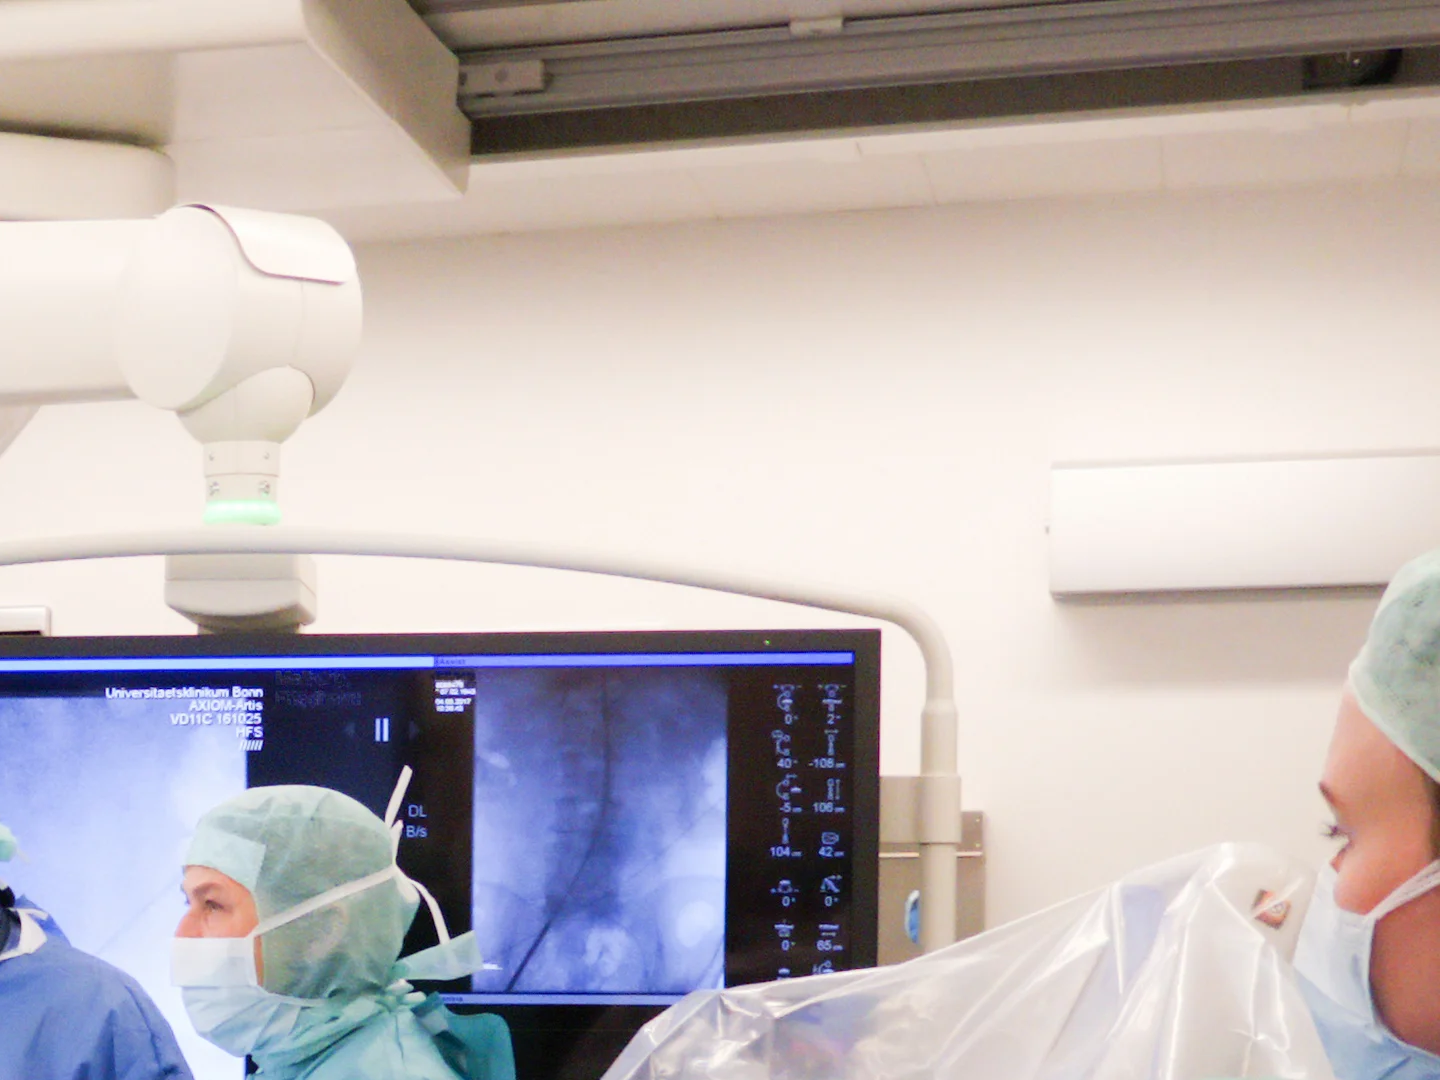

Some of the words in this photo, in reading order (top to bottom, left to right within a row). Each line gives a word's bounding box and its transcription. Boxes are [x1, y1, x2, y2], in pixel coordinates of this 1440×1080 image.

[105, 687, 229, 699] Universitaetsklinikum
[232, 686, 264, 698] Bonn
[189, 700, 264, 711] AXIOM-Artis
[170, 713, 213, 725] VD11C
[217, 713, 262, 725] 161025
[236, 726, 264, 738] HFS
[408, 804, 427, 818] DL
[406, 826, 428, 838] B/s
